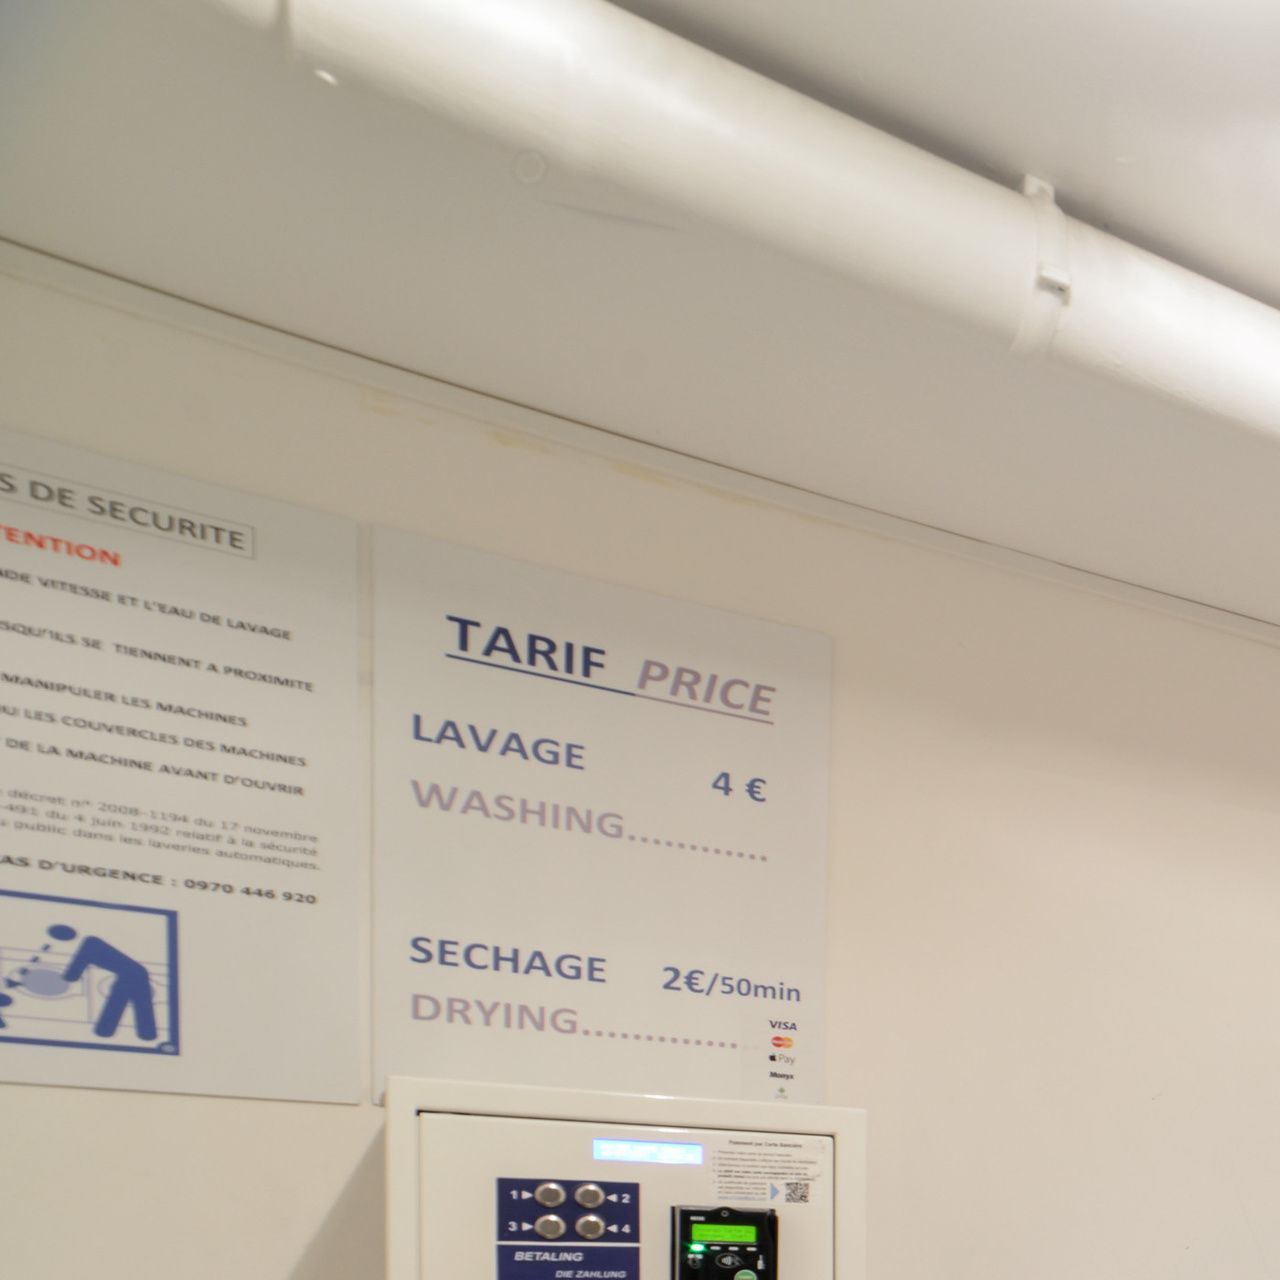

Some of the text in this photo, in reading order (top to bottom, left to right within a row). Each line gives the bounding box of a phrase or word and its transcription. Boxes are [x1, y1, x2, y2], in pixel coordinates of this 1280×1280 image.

[29, 480, 75, 509] DE
[88, 496, 244, 550] SECURITE
[38, 577, 292, 641] VITESSE ET L'EAU DE LAVAGE
[82, 637, 102, 650] SE
[114, 644, 202, 670] TIENNENT
[206, 663, 220, 673] A
[223, 666, 314, 692] PROXIMITE
[446, 615, 776, 715] TARIF PRICE
[0, 672, 248, 727] MANIPULER LES MACHINES
[24, 709, 308, 767] LES COUVERCLES DES MACHINES
[413, 714, 585, 770] LAVAGE
[5, 738, 305, 796] DE LA MACHINE AVANT D'OUVRIR
[712, 772, 767, 802] 4 €
[38, 860, 318, 904] D'URGENCE 0970 446 920
[410, 937, 606, 983] SECHAGE
[663, 967, 801, 1006] 2€/50min
[769, 1020, 797, 1030] VISA
[510, 1190, 517, 1200] 1
[622, 1193, 630, 1203] 2
[508, 1221, 517, 1231] 3
[621, 1224, 631, 1234] 4
[514, 1251, 584, 1262] BETALING
[555, 1270, 627, 1278] DIE ZAHLUNG
